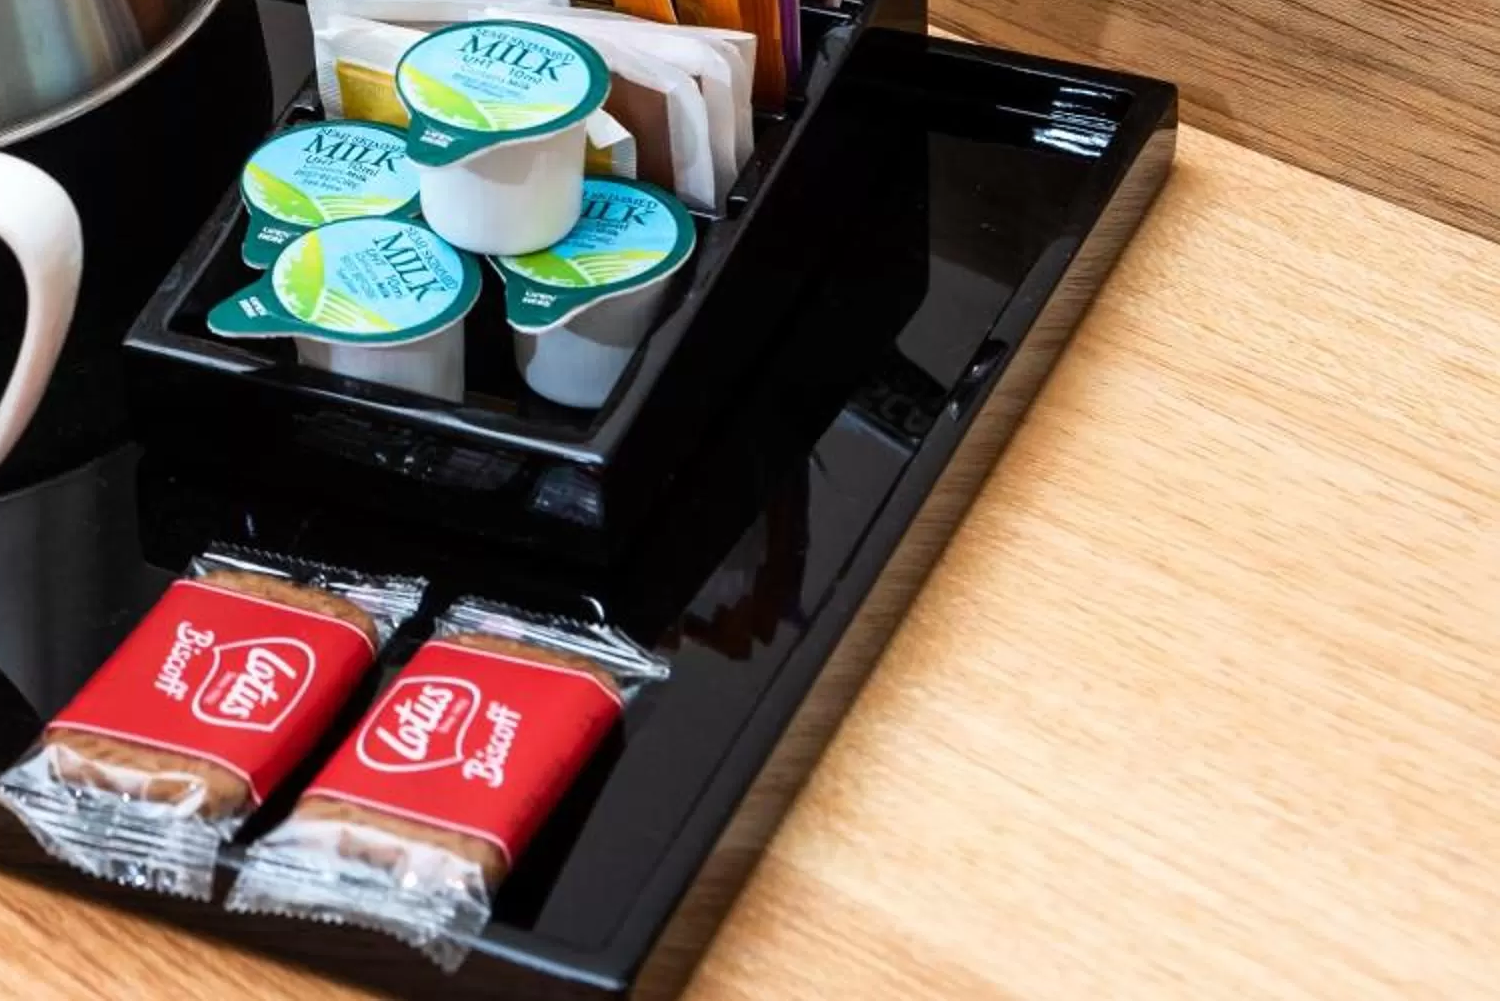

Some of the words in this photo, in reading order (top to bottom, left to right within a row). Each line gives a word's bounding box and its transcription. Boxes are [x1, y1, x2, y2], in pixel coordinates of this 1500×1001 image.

[457, 34, 572, 81] MILK
[303, 134, 405, 174] MILK
[580, 200, 656, 227] ILK
[372, 230, 447, 302] MILK
[153, 620, 215, 701] Biscoff
[219, 647, 297, 719] Lotus
[375, 682, 454, 760] Lotus
[461, 700, 522, 788] Biscoff
